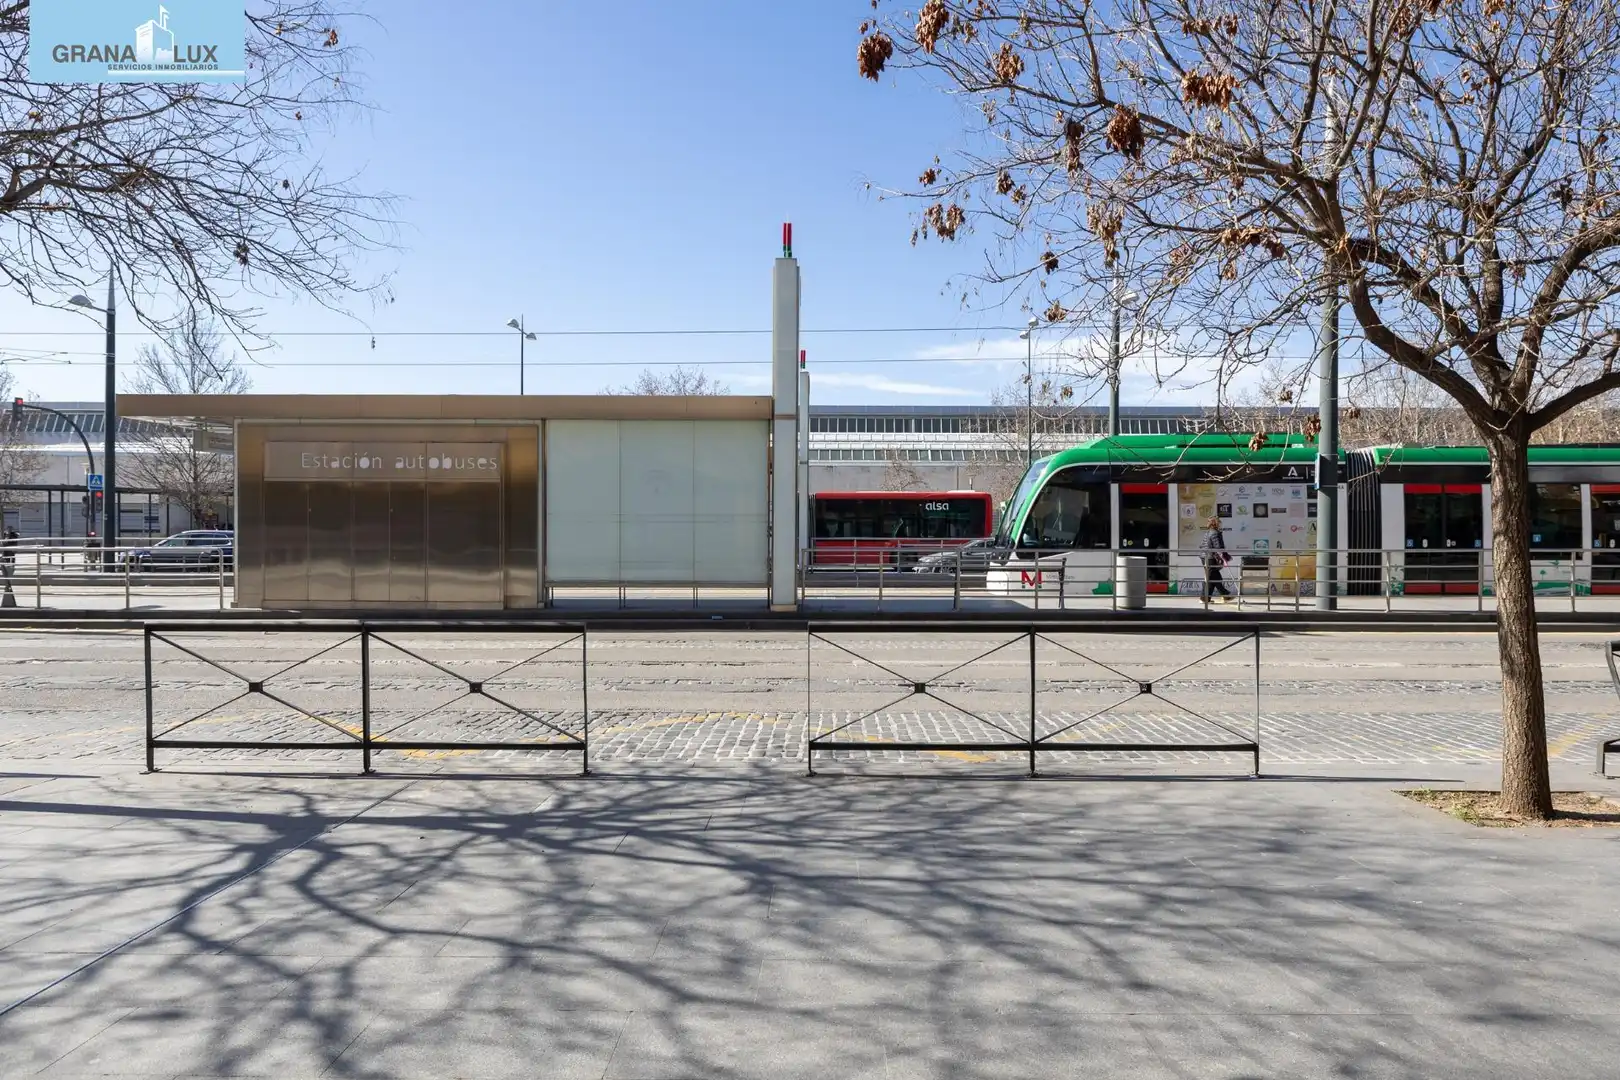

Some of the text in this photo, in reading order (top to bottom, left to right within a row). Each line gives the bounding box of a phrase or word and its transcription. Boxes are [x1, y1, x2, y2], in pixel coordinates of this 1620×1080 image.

[301, 452, 498, 469] Estación autobuses
[925, 501, 950, 511] alsa
[1021, 568, 1042, 587] M
